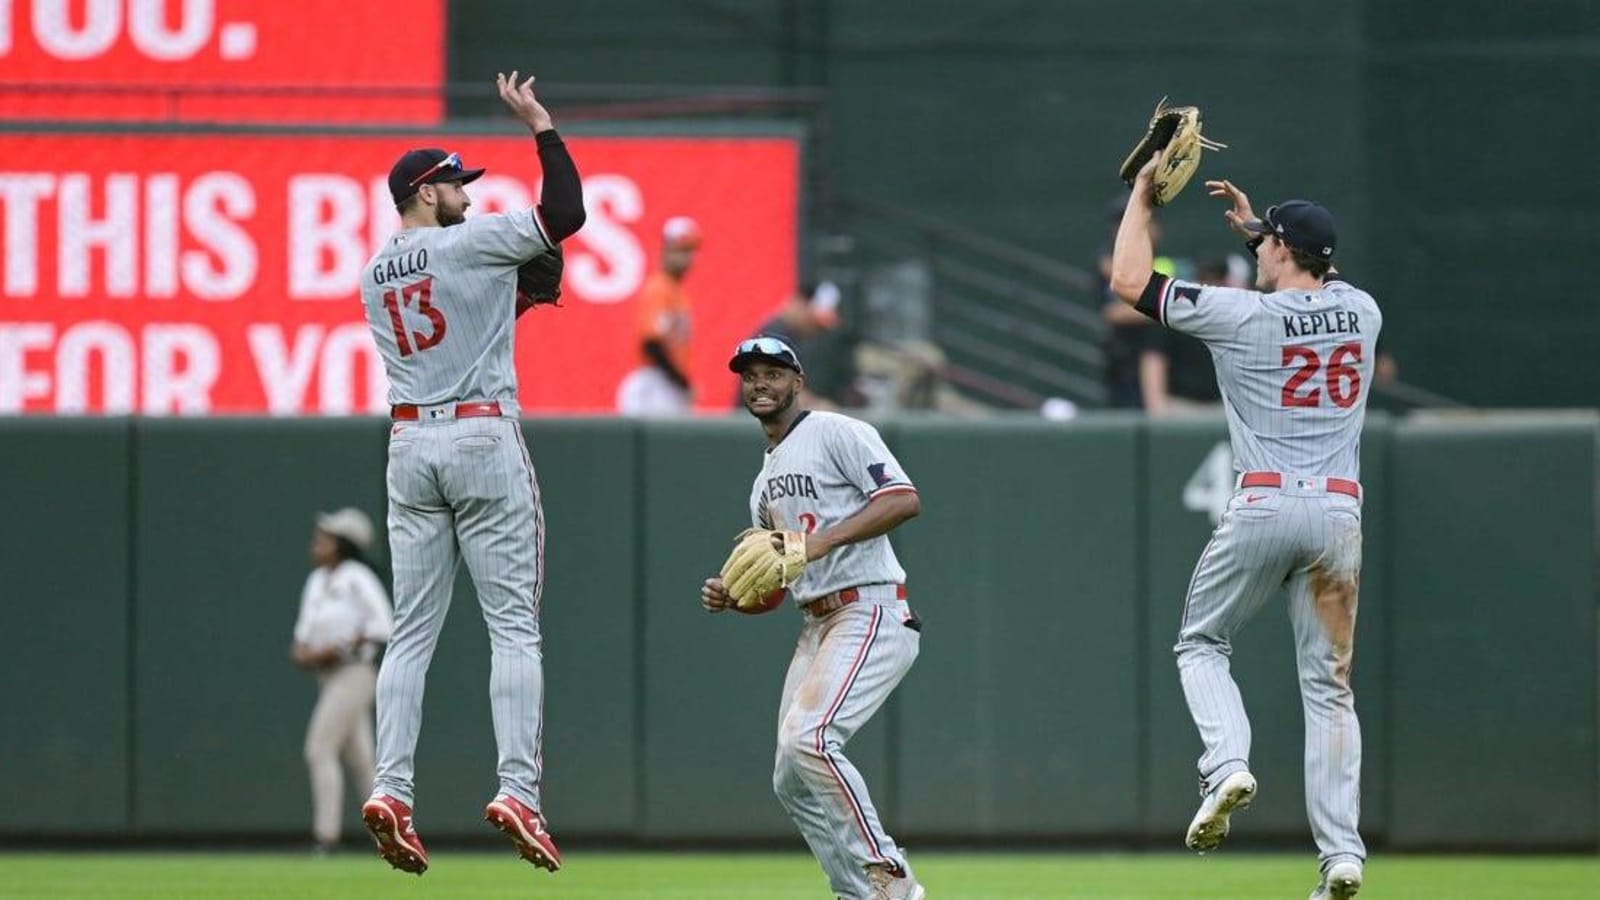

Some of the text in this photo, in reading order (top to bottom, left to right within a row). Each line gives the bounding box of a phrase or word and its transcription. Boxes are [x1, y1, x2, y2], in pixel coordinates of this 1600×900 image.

[0, 0, 257, 61] OU.
[0, 170, 259, 301] THIS
[373, 248, 427, 285] GALLO
[383, 277, 446, 357] 13
[1283, 311, 1360, 337] KEPLER
[0, 321, 389, 417] FOR YO
[1281, 343, 1362, 408] 26
